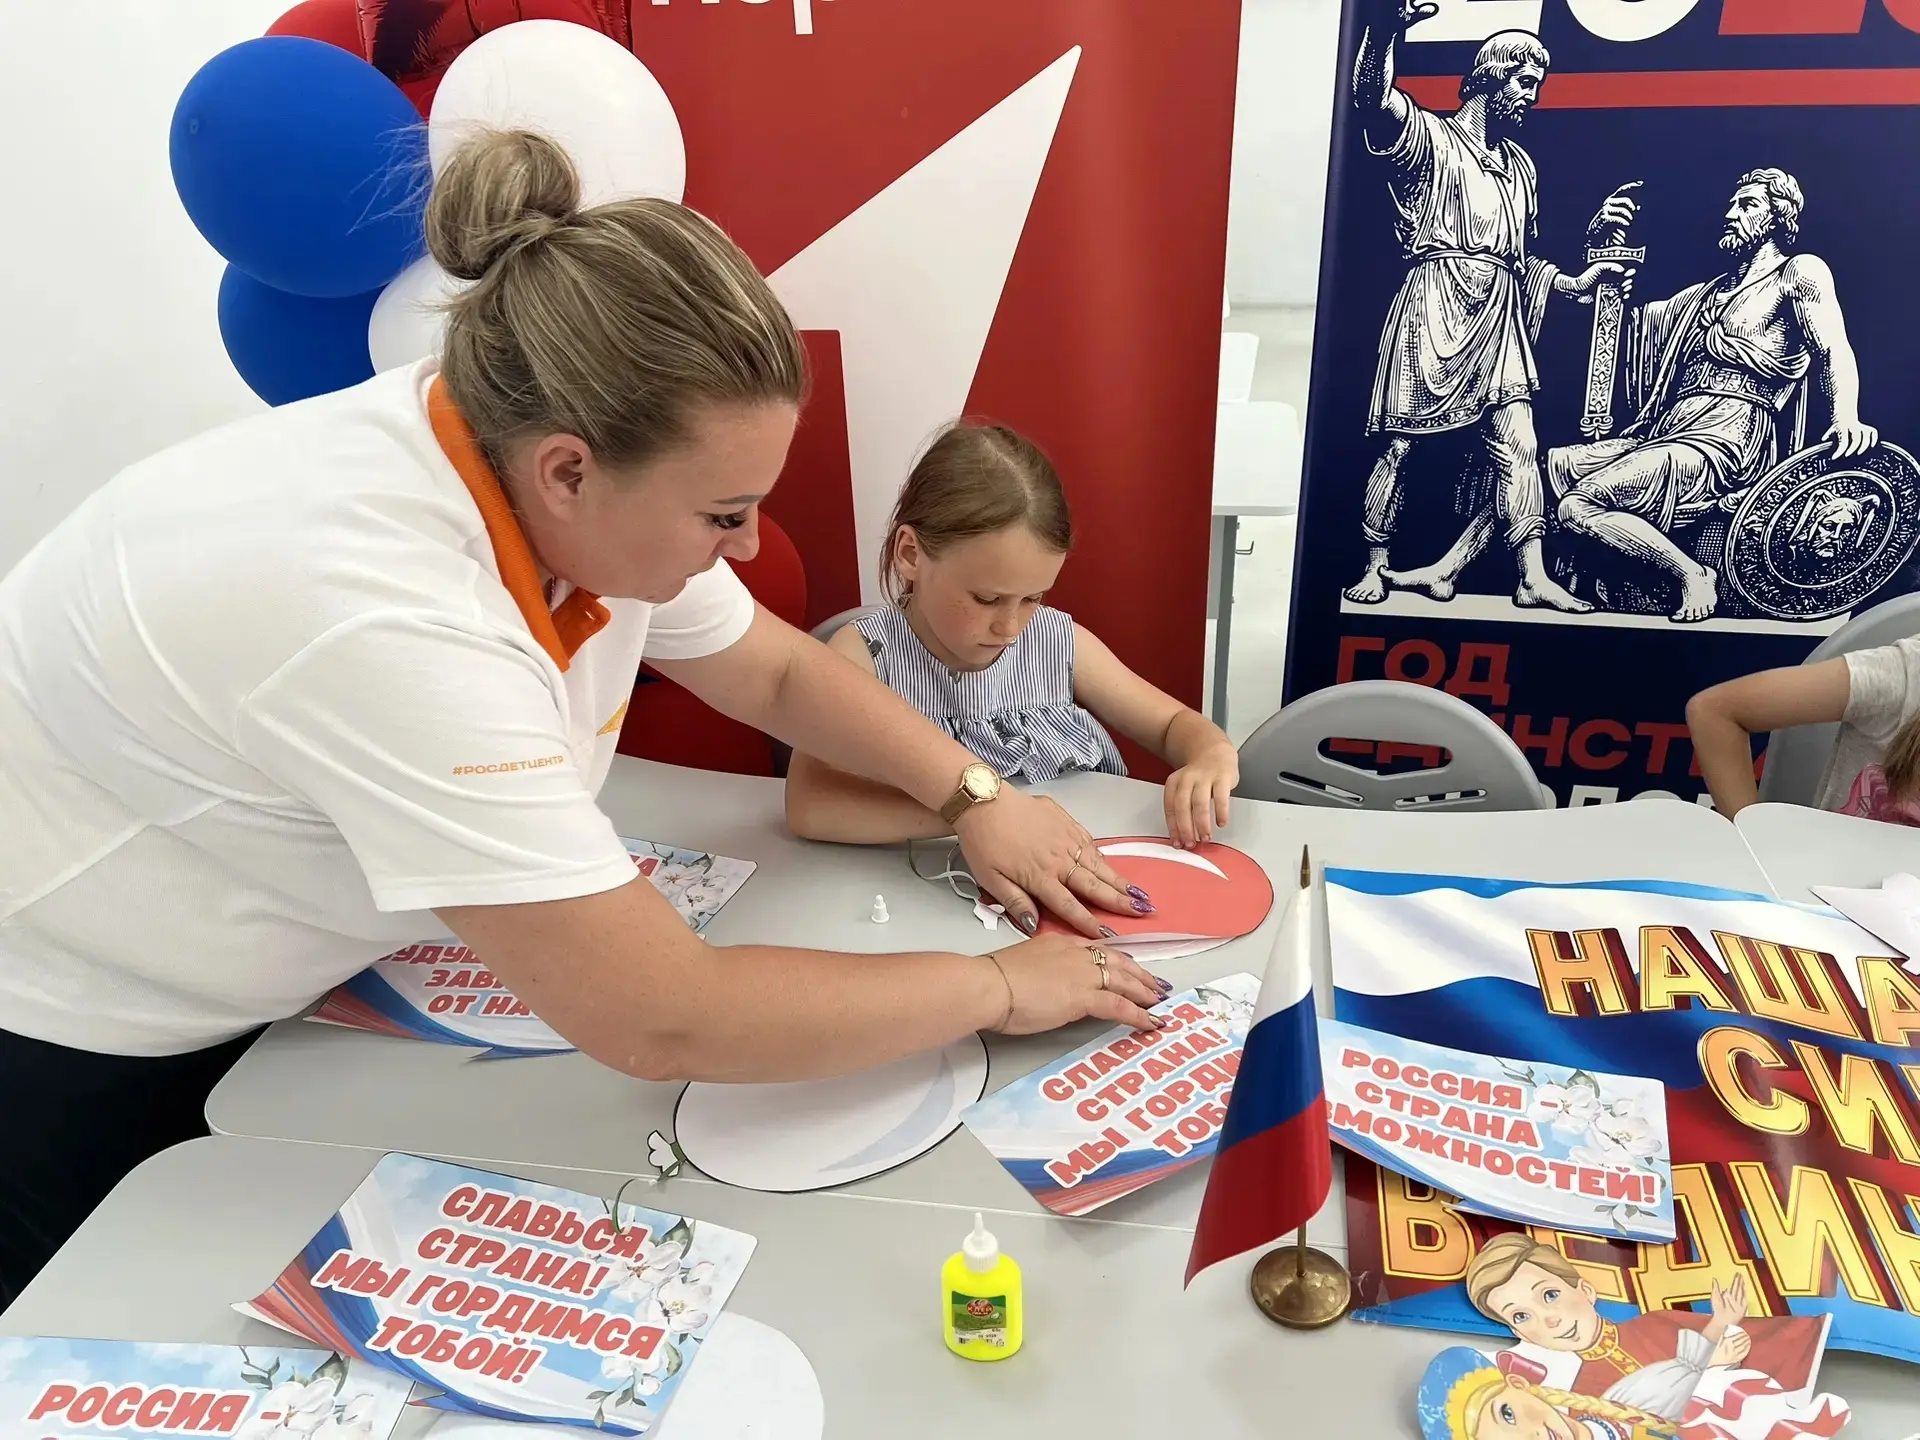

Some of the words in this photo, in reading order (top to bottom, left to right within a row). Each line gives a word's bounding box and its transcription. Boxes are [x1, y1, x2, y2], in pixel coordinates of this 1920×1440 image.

[1337, 636, 1510, 705] ГОД
[453, 756, 564, 775] #РОСДЕТЦЕНТР
[427, 995, 477, 1014] ОТ
[1076, 1026, 1229, 1122] СТРАНА!
[1342, 1048, 1523, 1110] РОССИЯ
[1697, 1026, 1920, 1167] СИ
[1048, 1127, 1130, 1185] МЫ
[1124, 1049, 1243, 1132] ГОРДИ
[1355, 1081, 1540, 1148] СТРАНА
[442, 1186, 647, 1263] СЛАВЬСЯ,
[418, 1228, 610, 1297] СТРАНА!
[321, 1254, 413, 1298] МЫ
[409, 1275, 666, 1361] ГОРДИМСЯ
[372, 1316, 545, 1384] ТОБОЙ!
[28, 1384, 250, 1432] РОССИЯ
